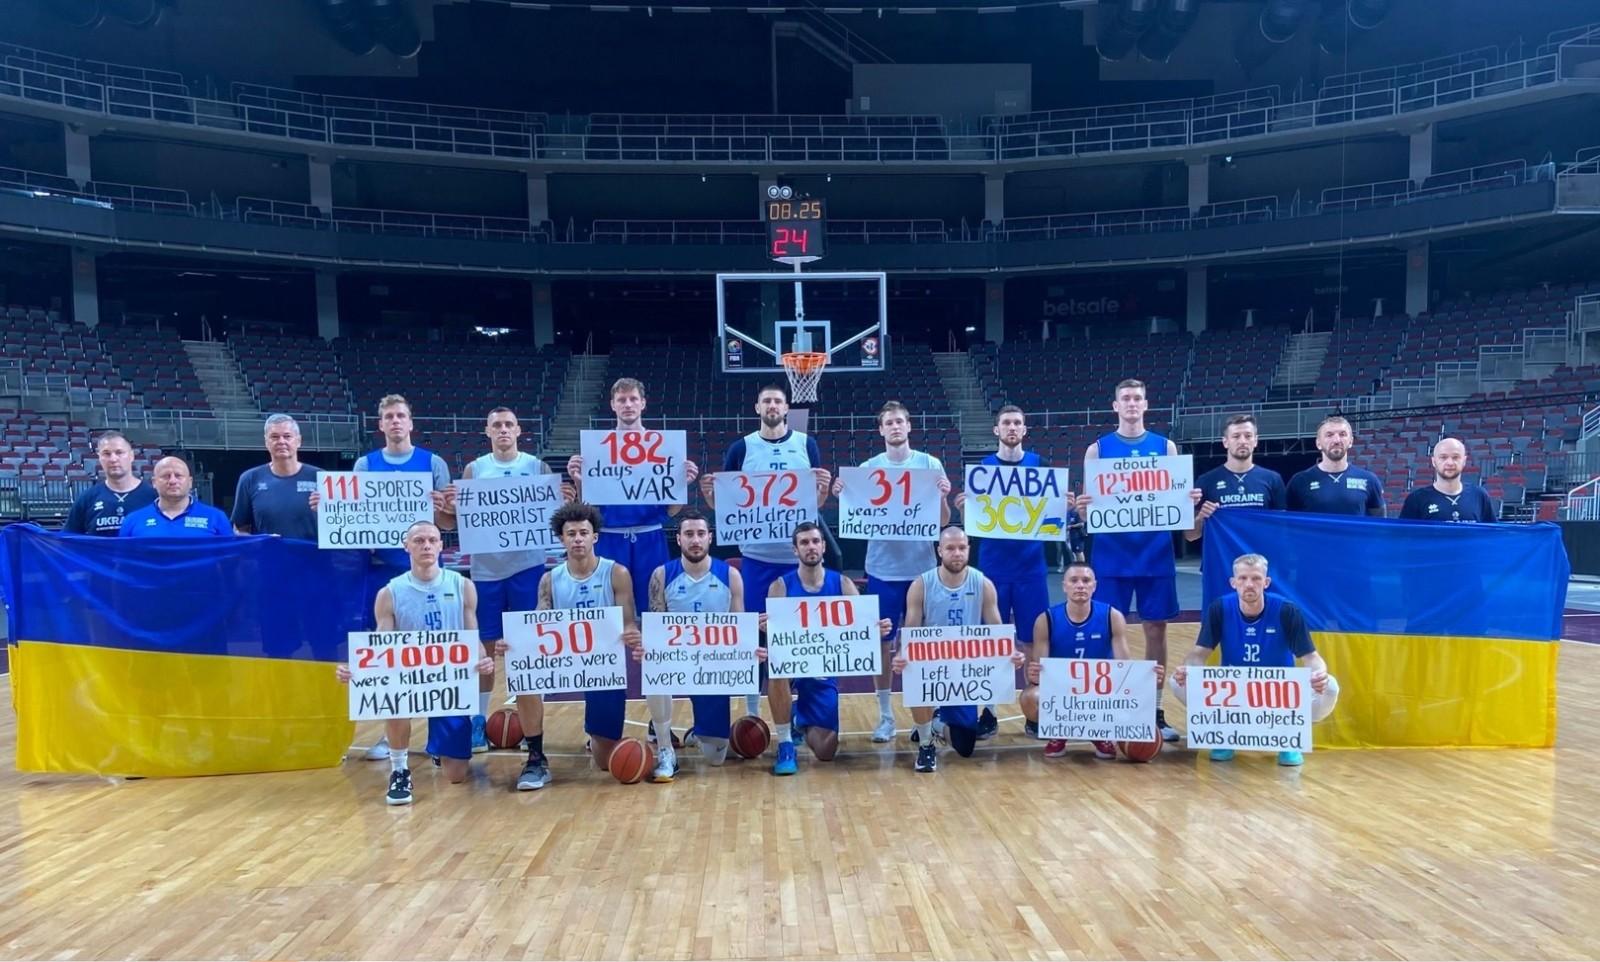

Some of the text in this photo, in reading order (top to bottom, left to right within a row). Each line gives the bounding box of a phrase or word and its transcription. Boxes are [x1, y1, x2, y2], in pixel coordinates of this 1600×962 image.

[773, 229, 808, 254] 24
[1042, 296, 1120, 316] betsafe
[600, 431, 667, 465] 182
[588, 456, 675, 480] days of
[1110, 457, 1158, 470] about
[323, 475, 359, 500] 111
[364, 480, 424, 499] SPORTS
[621, 475, 678, 501] WAR
[732, 473, 798, 507] 372
[868, 469, 911, 506] 31
[968, 466, 1060, 498] СЛАВА
[1094, 469, 1170, 496] 125000
[324, 498, 428, 515] infrastructure
[1115, 493, 1156, 504] was
[1219, 493, 1264, 503] UKRAINE
[326, 512, 416, 528] objects was
[848, 502, 922, 521] years of
[976, 495, 1048, 534] ЗСУ
[1090, 504, 1182, 529] OCCUPIED
[720, 527, 762, 541] were
[842, 520, 937, 537] independence
[524, 608, 605, 624] more than
[662, 612, 738, 625] more than
[794, 599, 854, 628] 110
[368, 630, 460, 646] more than
[536, 621, 593, 656] 50
[667, 624, 739, 646] 2300
[839, 625, 870, 641] and
[910, 625, 991, 638] more than
[355, 644, 469, 669] 21000
[644, 648, 752, 665] objects of education
[791, 640, 850, 656] coaches
[1243, 643, 1260, 662] 32
[580, 652, 617, 666] were
[770, 660, 809, 675] were
[351, 675, 390, 688] were
[454, 667, 470, 680] in
[560, 673, 570, 688] in
[573, 669, 626, 689] Olenivka
[645, 664, 755, 687] were damaged
[921, 663, 995, 681] Left their
[1203, 667, 1286, 680] more than
[1042, 695, 1139, 714] of Ukrainians
[1203, 680, 1301, 710] 22 000
[1103, 712, 1114, 722] in
[1255, 710, 1305, 729] objects
[1040, 722, 1085, 737] victory
[1088, 728, 1113, 739] over
